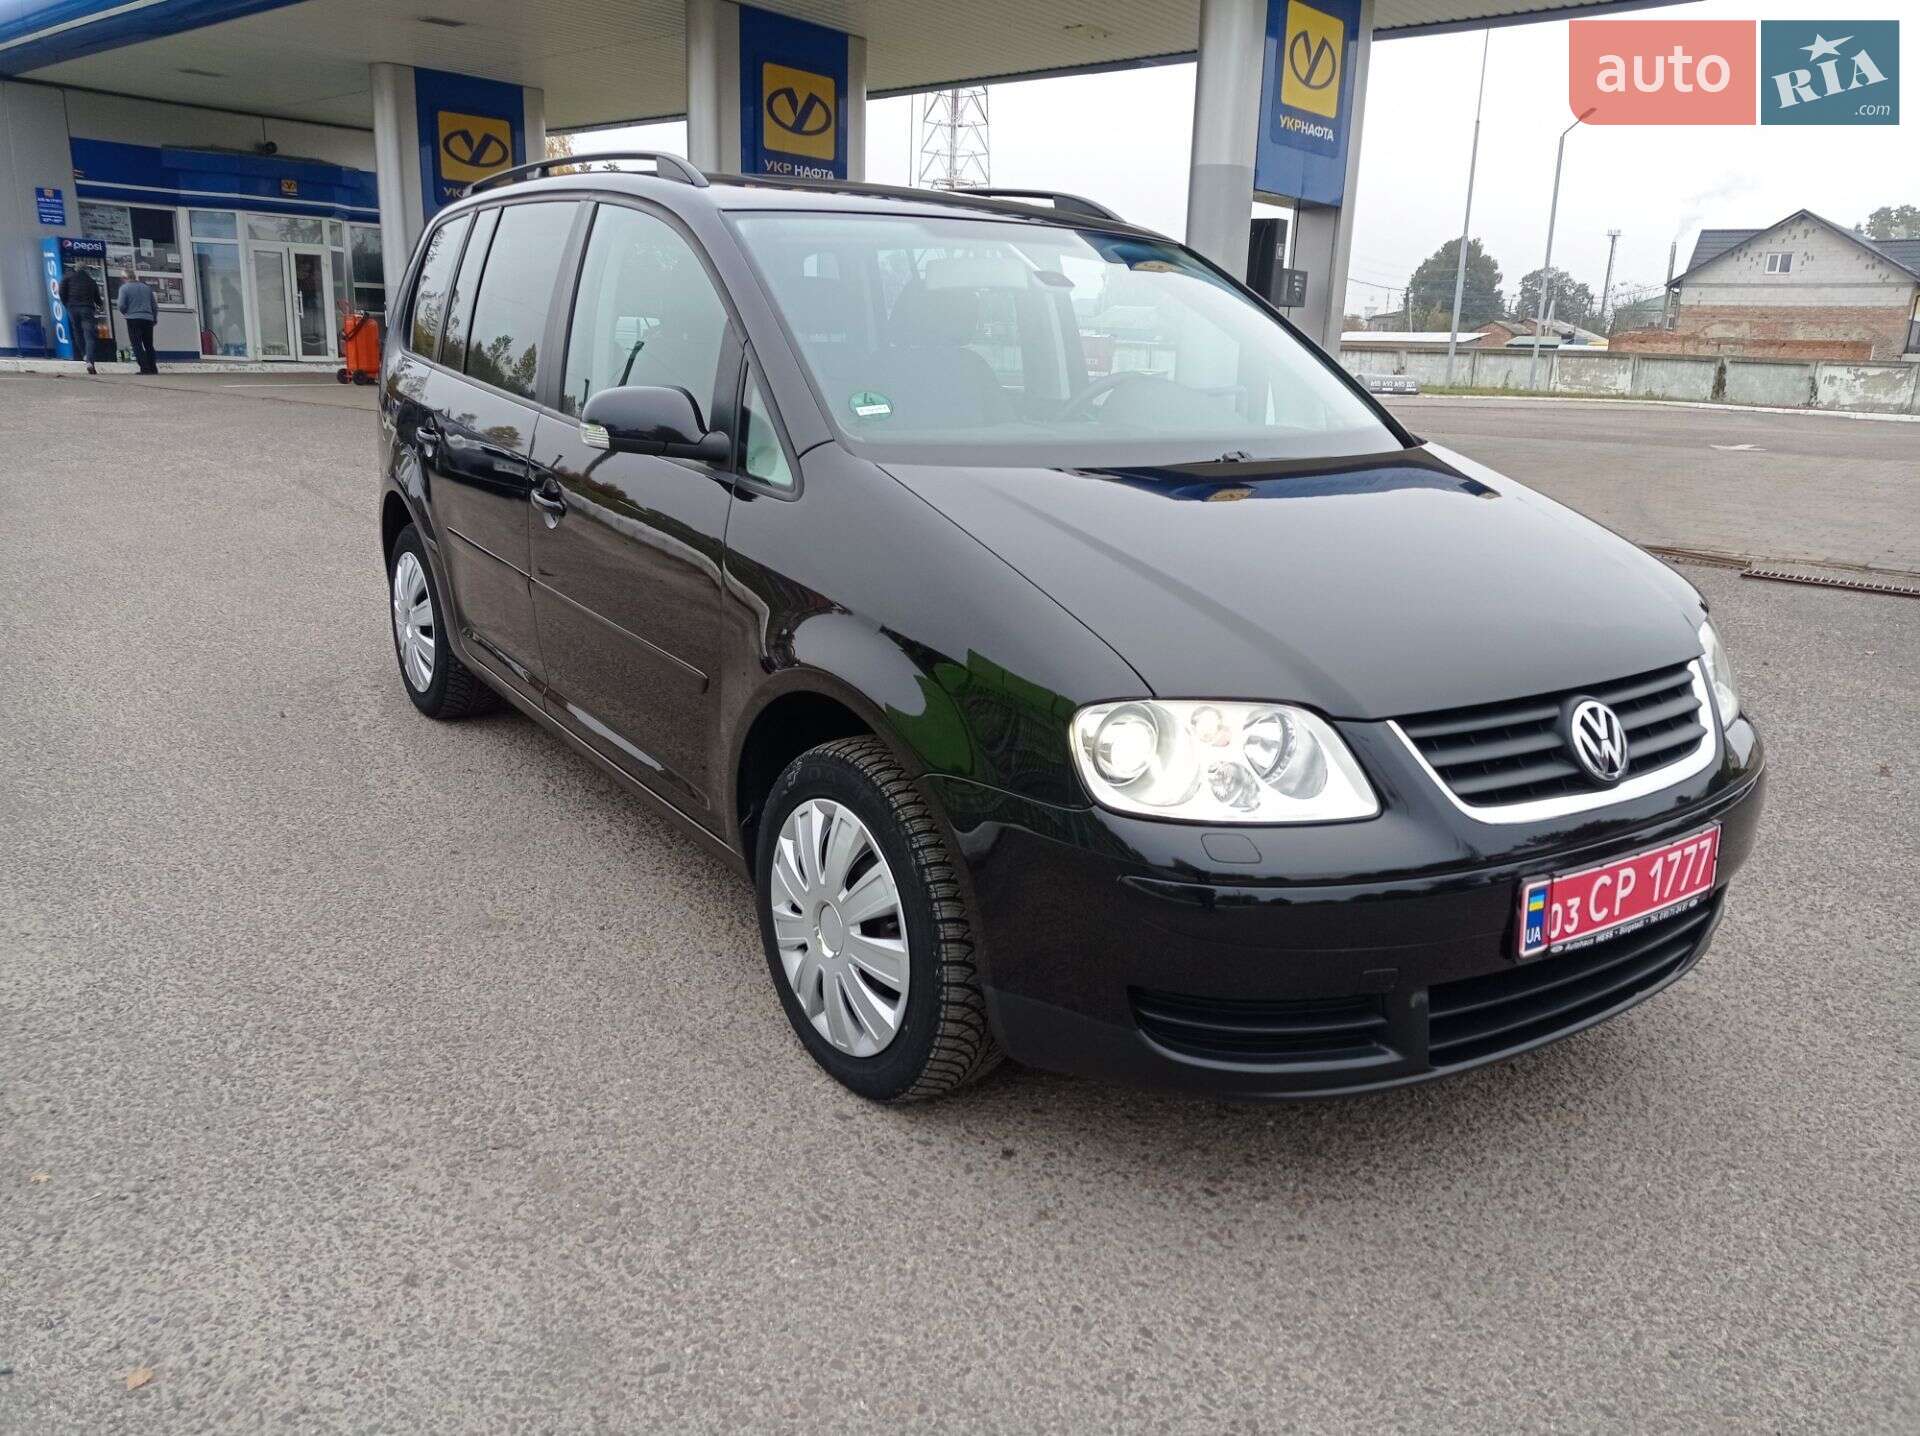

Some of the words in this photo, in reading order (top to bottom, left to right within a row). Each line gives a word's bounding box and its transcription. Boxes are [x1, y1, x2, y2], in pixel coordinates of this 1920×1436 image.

[1279, 114, 1334, 142] УКРНАФТА
[794, 164, 835, 180] НАФТА
[73, 241, 103, 252] pepsi
[42, 250, 70, 345] pepsi
[1547, 897, 1581, 940] 03
[1588, 866, 1636, 922] CP
[1649, 838, 1713, 902] 1777
[1526, 926, 1542, 944] UA
